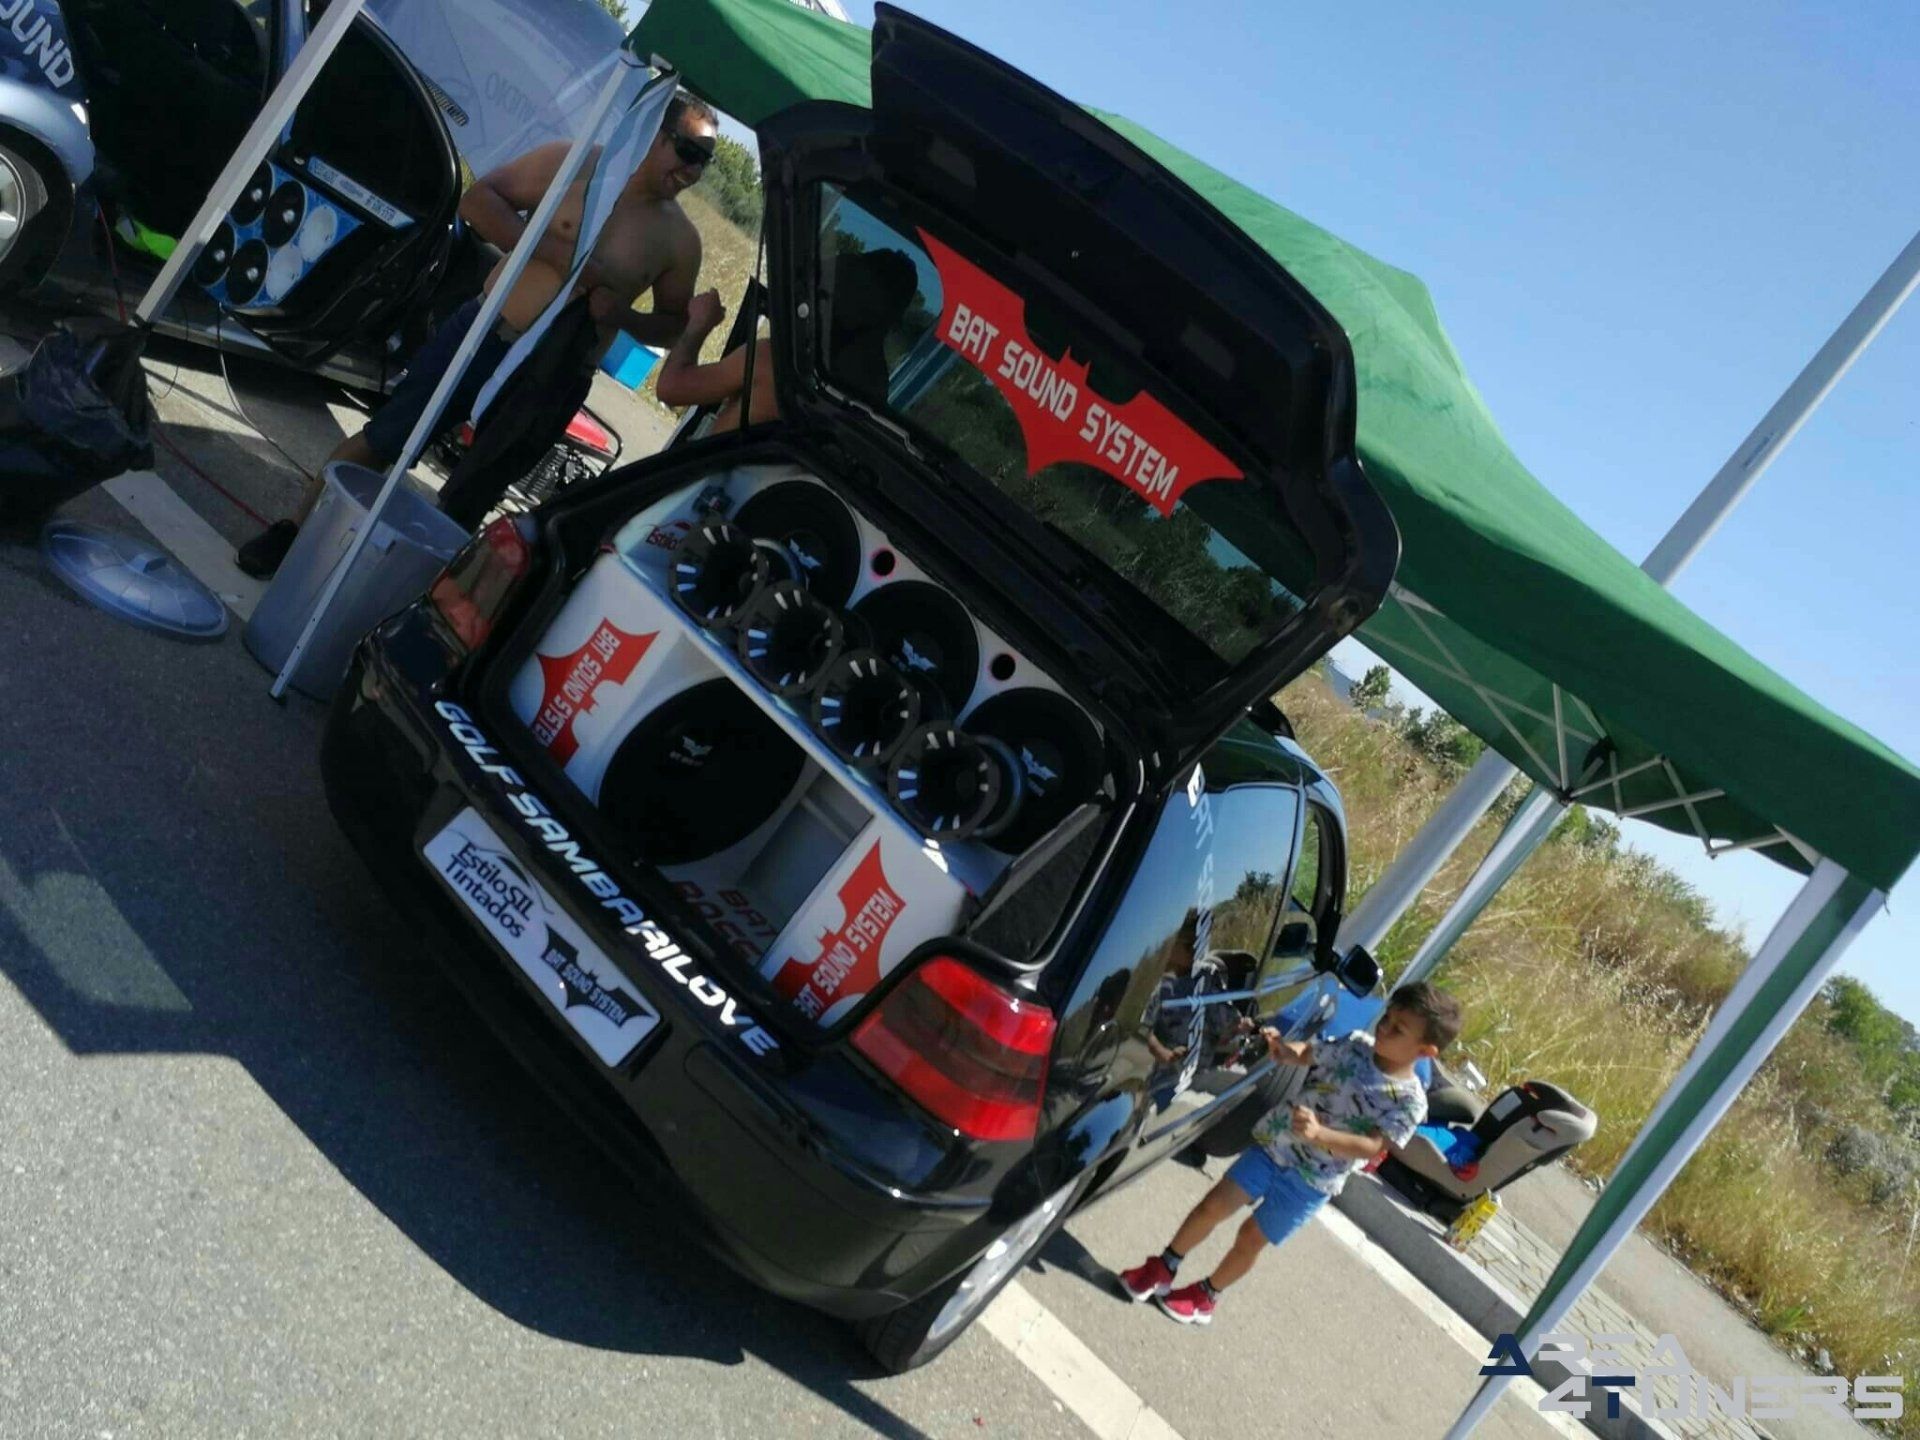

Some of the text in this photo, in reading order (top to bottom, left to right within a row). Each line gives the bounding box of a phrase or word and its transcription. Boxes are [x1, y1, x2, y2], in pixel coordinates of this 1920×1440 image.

[949, 303, 1180, 501] BAT SOUND SYSTEM
[562, 652, 602, 703] SOUND
[590, 626, 622, 663] BAT
[434, 700, 526, 787] GOLF
[445, 853, 525, 939] Tintados
[811, 939, 858, 996] SOUND
[844, 886, 899, 953] SYSTEM
